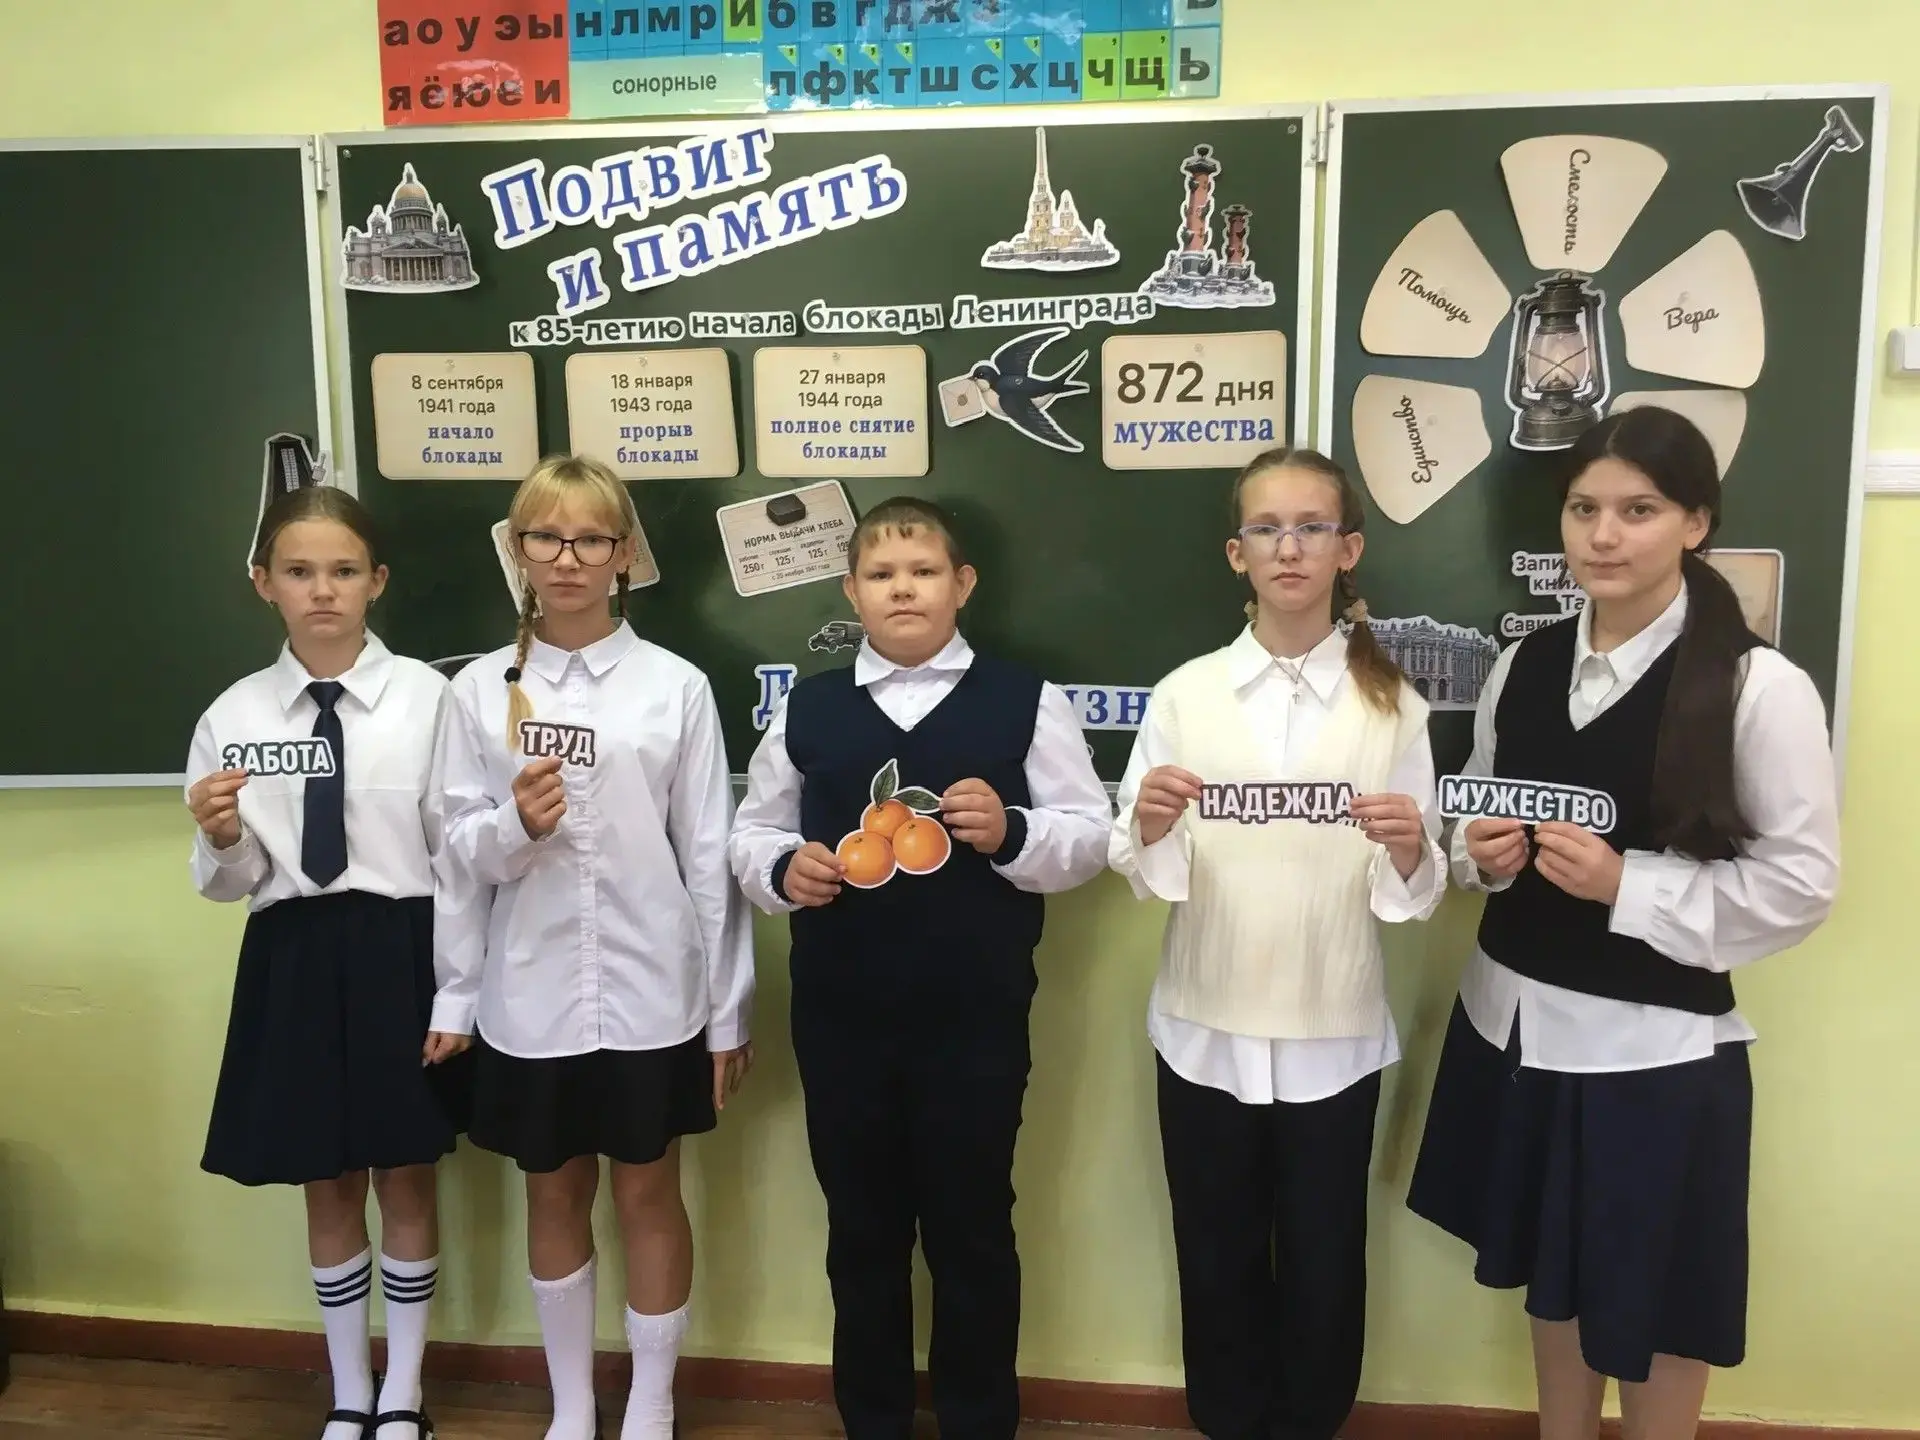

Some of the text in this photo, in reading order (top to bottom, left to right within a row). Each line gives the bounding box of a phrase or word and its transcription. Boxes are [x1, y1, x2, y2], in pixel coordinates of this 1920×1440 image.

[612, 74, 717, 96] сонорные
[489, 128, 767, 241] Подвиг
[1564, 148, 1591, 255] Смелость
[556, 163, 900, 309] и память
[1400, 267, 1472, 325] Помощь
[513, 295, 1151, 343] к 85-летию начала блокады Ленинграда
[1663, 306, 1720, 334] Вера
[411, 375, 504, 393] 8 сентября
[611, 374, 693, 390] 18 января
[799, 369, 886, 388] 27 января
[1117, 361, 1274, 406] 872 дня
[418, 398, 495, 415] 1941 года
[610, 397, 693, 413] 1943 года
[798, 392, 883, 409] 1944 года
[428, 427, 494, 439] начало
[620, 424, 693, 442] прорыв
[770, 419, 915, 434] полное снятие
[1113, 418, 1275, 450] мужества
[1392, 394, 1440, 484] Единство
[422, 447, 503, 465] блокады
[617, 447, 699, 463] блокады
[802, 442, 887, 460] блокады
[744, 519, 844, 548] НОРМА ВЫДАЧИ ХЛЕБА
[743, 562, 760, 575] 250
[775, 555, 791, 567] 125
[808, 547, 824, 559] 125
[223, 741, 333, 775] ЗАБОТА
[521, 723, 594, 766] ТРУД
[1201, 784, 1354, 822] НАДЕЖДА
[1444, 780, 1613, 830] МУЖЕСТВО
